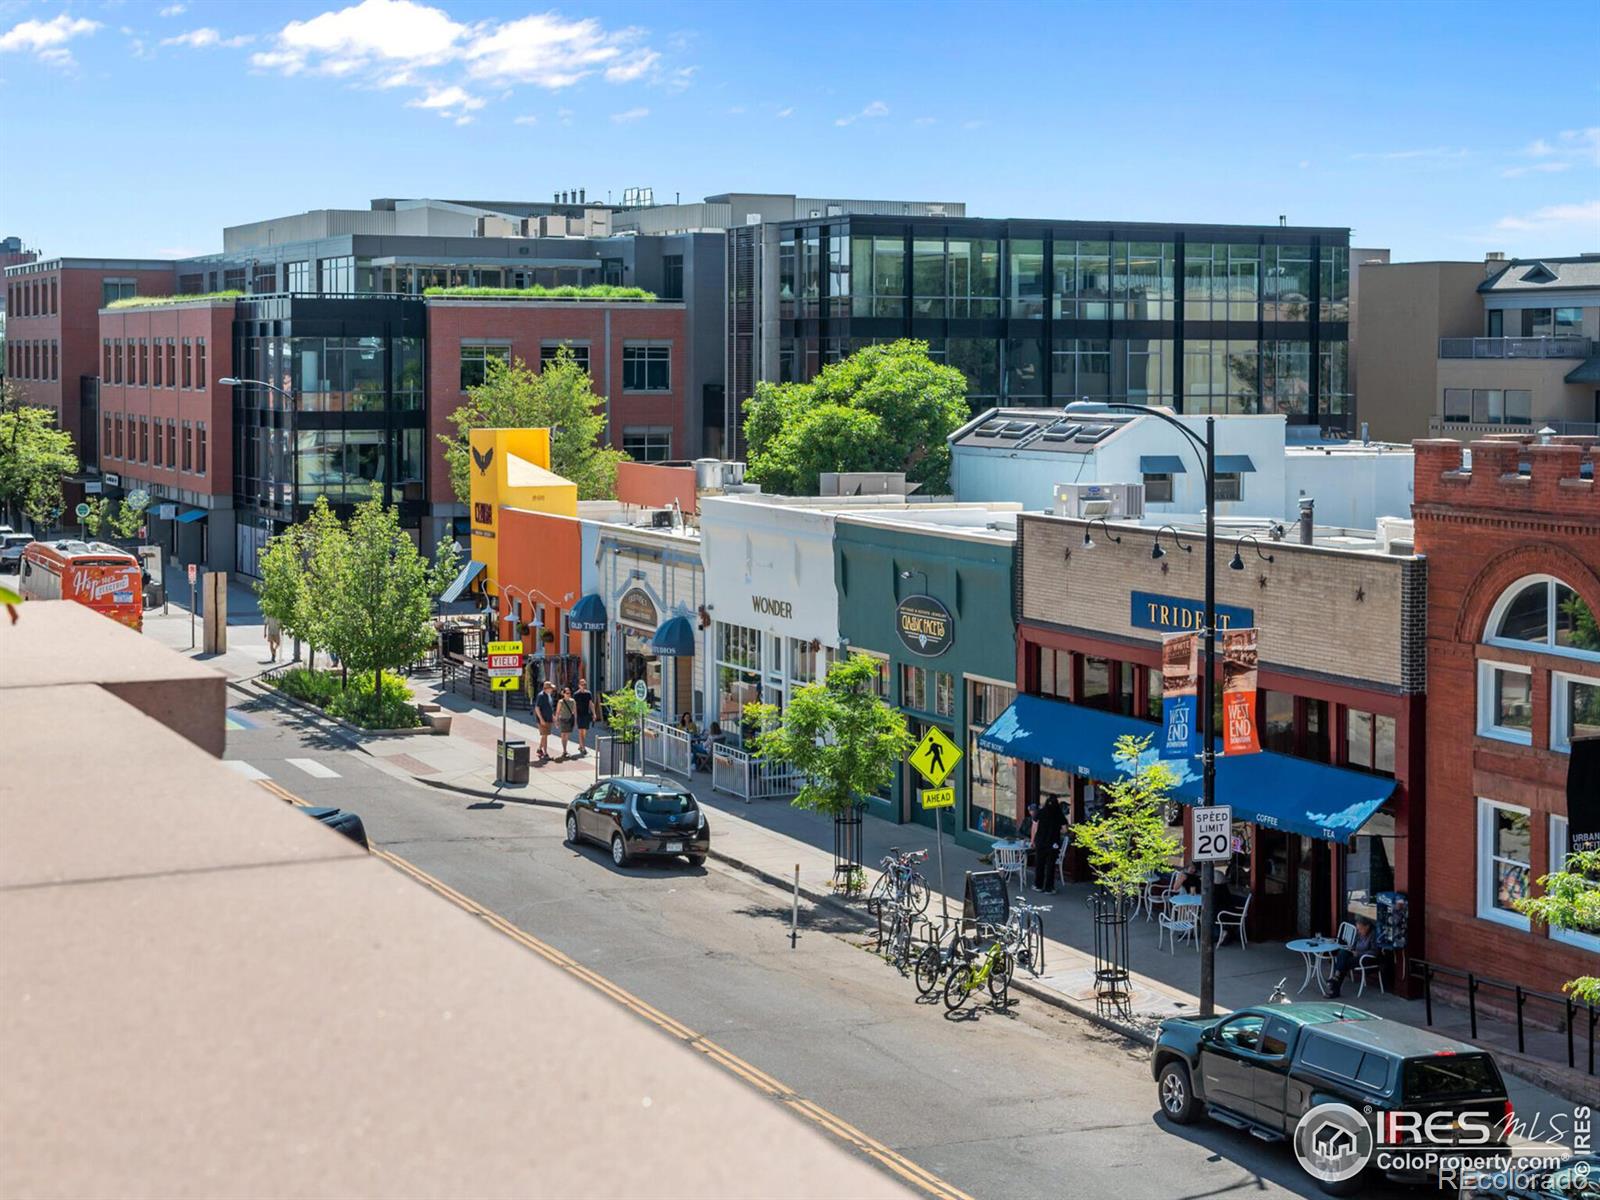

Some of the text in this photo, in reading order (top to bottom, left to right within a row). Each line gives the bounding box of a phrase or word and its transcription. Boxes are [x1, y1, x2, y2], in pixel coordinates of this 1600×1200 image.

[752, 595, 793, 619] WONDER
[1148, 603, 1230, 629] TRIDET
[571, 622, 606, 630] OLD TIBET
[493, 656, 518, 666] YIELD
[1170, 707, 1190, 724] WEST
[1228, 704, 1249, 720] WEST
[1168, 723, 1189, 741] END
[1230, 719, 1251, 737] END
[927, 792, 951, 803] AHEAD
[1196, 812, 1229, 823] SPEED
[1256, 813, 1279, 826] COFFEE
[1199, 824, 1224, 833] LIMIT
[1323, 828, 1336, 839] TEA
[1573, 832, 1600, 842] URBAN
[1198, 834, 1228, 854] 20
